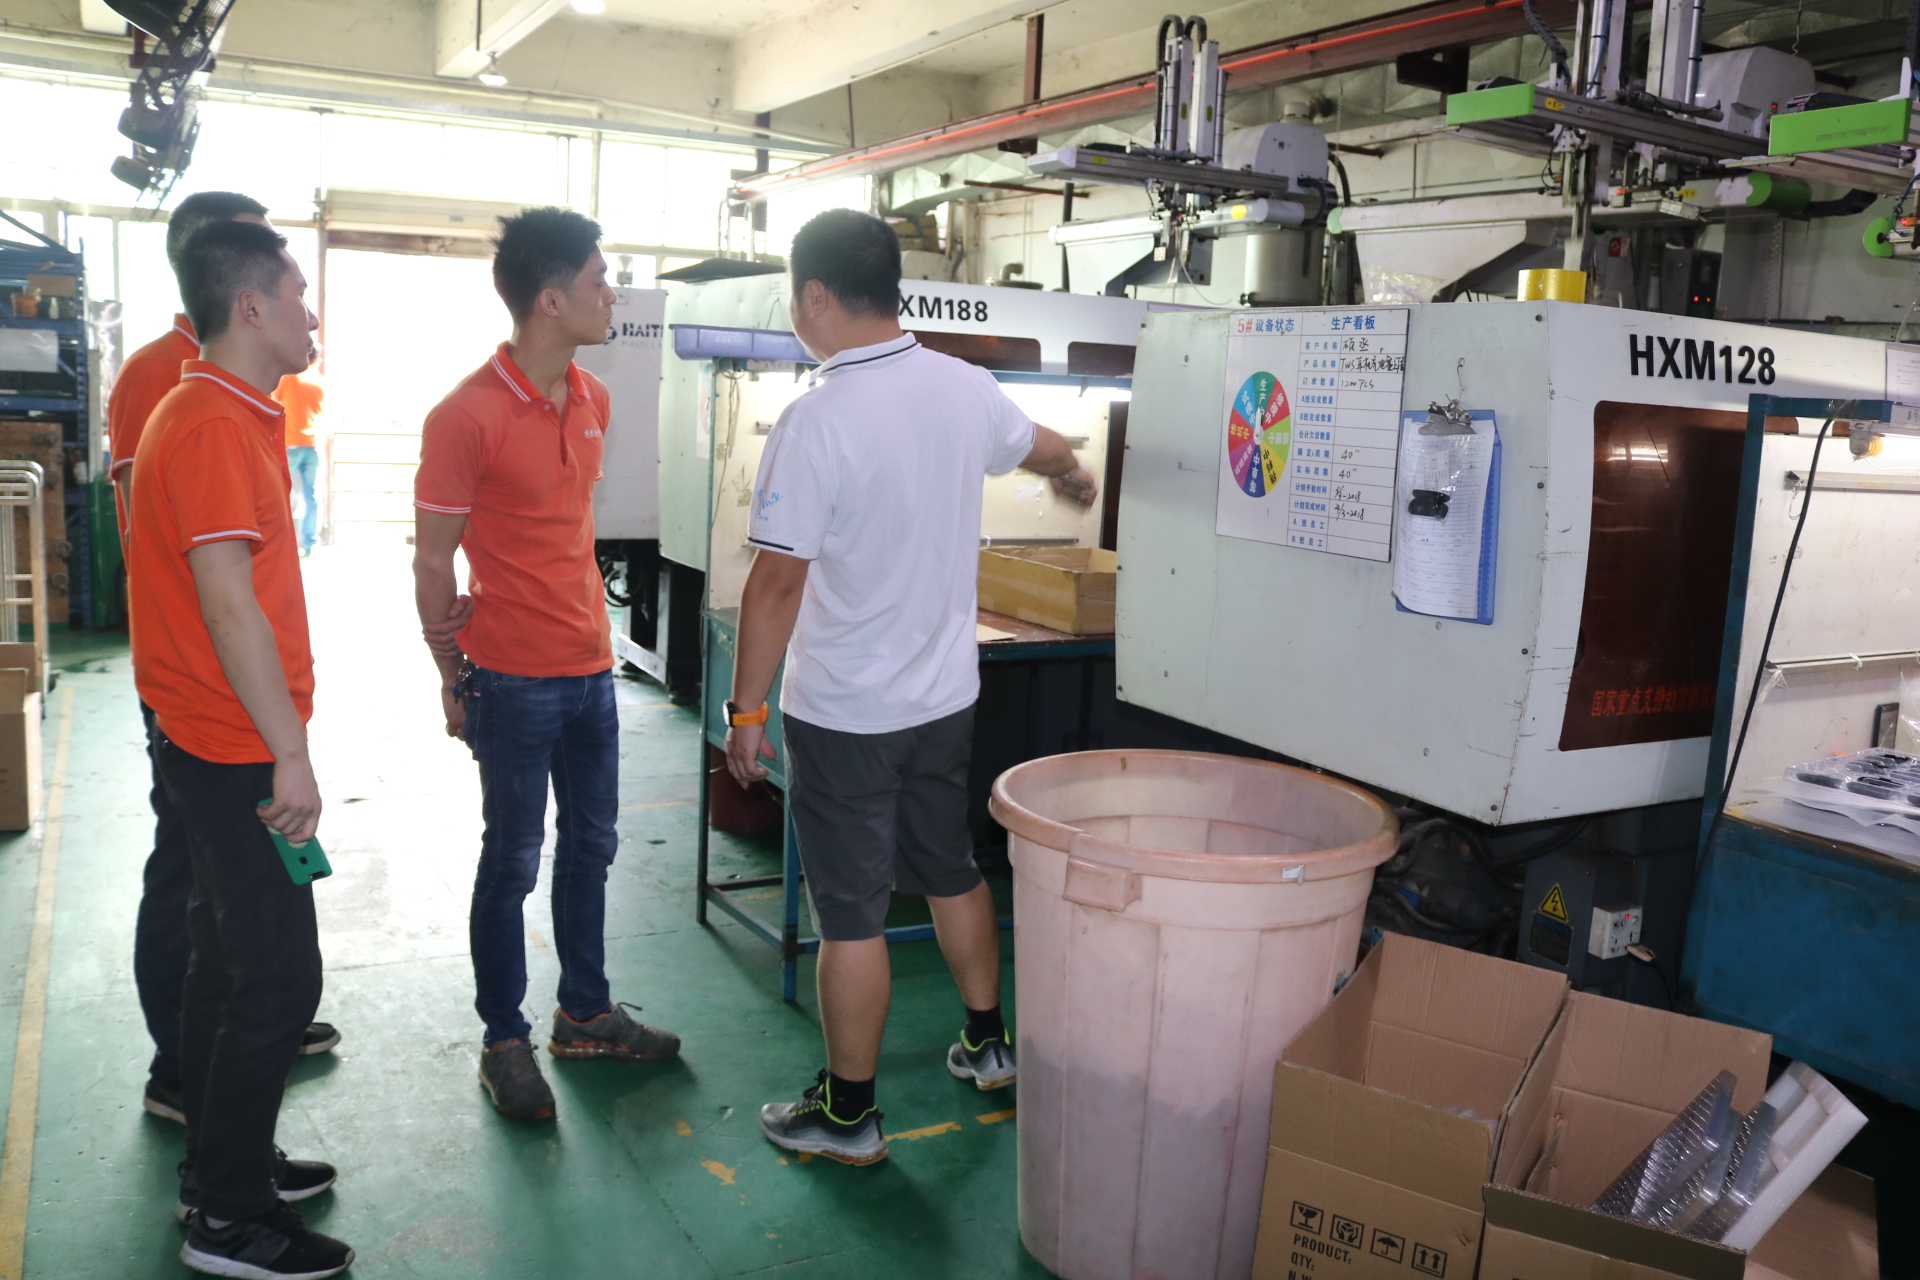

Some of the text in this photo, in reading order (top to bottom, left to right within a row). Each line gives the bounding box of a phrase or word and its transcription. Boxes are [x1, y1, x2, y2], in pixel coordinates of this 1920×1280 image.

[1255, 318, 1294, 332] 设备状态
[1331, 315, 1376, 331] 生产看板
[1305, 341, 1338, 350] 客户名称
[1303, 359, 1337, 369] 产品名称
[1630, 334, 1776, 385] HXM128
[1302, 377, 1334, 387] 订单数量
[1301, 395, 1333, 404] A班完成数量
[1300, 413, 1332, 422] B班完成数量
[1296, 466, 1329, 476] 实际周期
[1295, 483, 1327, 494] 计划开始时间
[1294, 500, 1326, 512] 计划完成时间
[1293, 1233, 1352, 1265] PRODUCT:
[1291, 1251, 1315, 1271] QTY:
